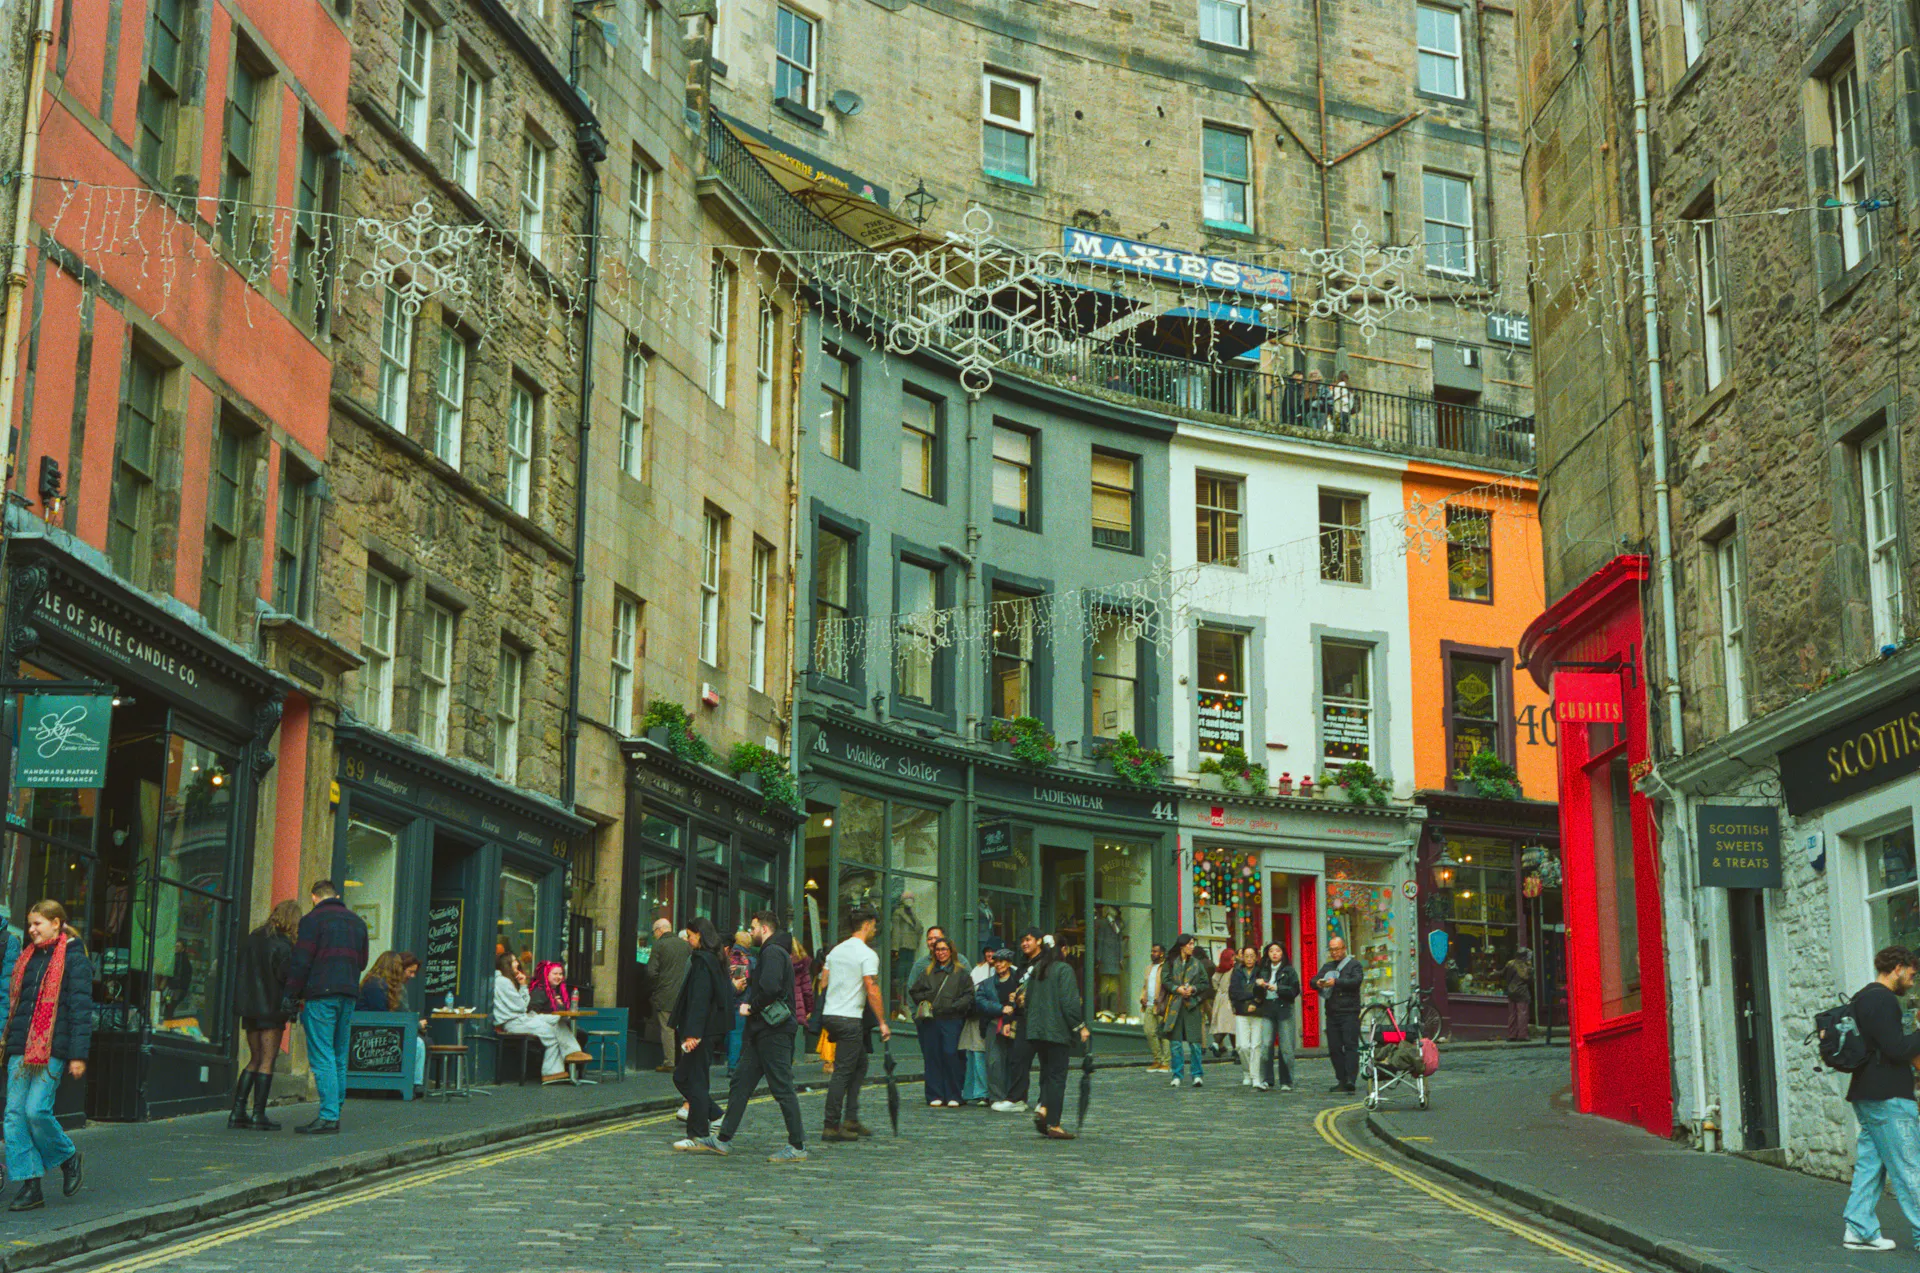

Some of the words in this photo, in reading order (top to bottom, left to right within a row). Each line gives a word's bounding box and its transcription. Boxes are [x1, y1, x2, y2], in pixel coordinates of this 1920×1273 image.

[861, 224, 896, 237] CASTLE
[1072, 233, 1241, 286] MAXIES
[1492, 316, 1529, 341] THE
[39, 591, 61, 614] LE
[66, 604, 85, 625] OF
[90, 615, 121, 647] SKYE
[127, 637, 175, 675] CANDLE
[179, 665, 198, 688] CO.
[1198, 706, 1220, 718] Loving
[1222, 709, 1241, 720] Local
[1559, 702, 1619, 719] CUBITTS
[36, 705, 87, 758] Skye
[1205, 719, 1219, 728] and
[1199, 728, 1219, 739] Since
[346, 757, 364, 781] 89
[846, 743, 889, 770] Walker
[898, 757, 941, 782] Slater
[1034, 787, 1103, 810] LADIESWEAR
[1211, 816, 1224, 824] red
[1226, 814, 1245, 825] door
[1250, 817, 1279, 831] gallery
[1709, 823, 1768, 836] SCOTTISH
[553, 839, 567, 858] 89
[1715, 840, 1764, 852] SWEETS
[1712, 858, 1721, 867] &
[1726, 857, 1769, 869] TREATS
